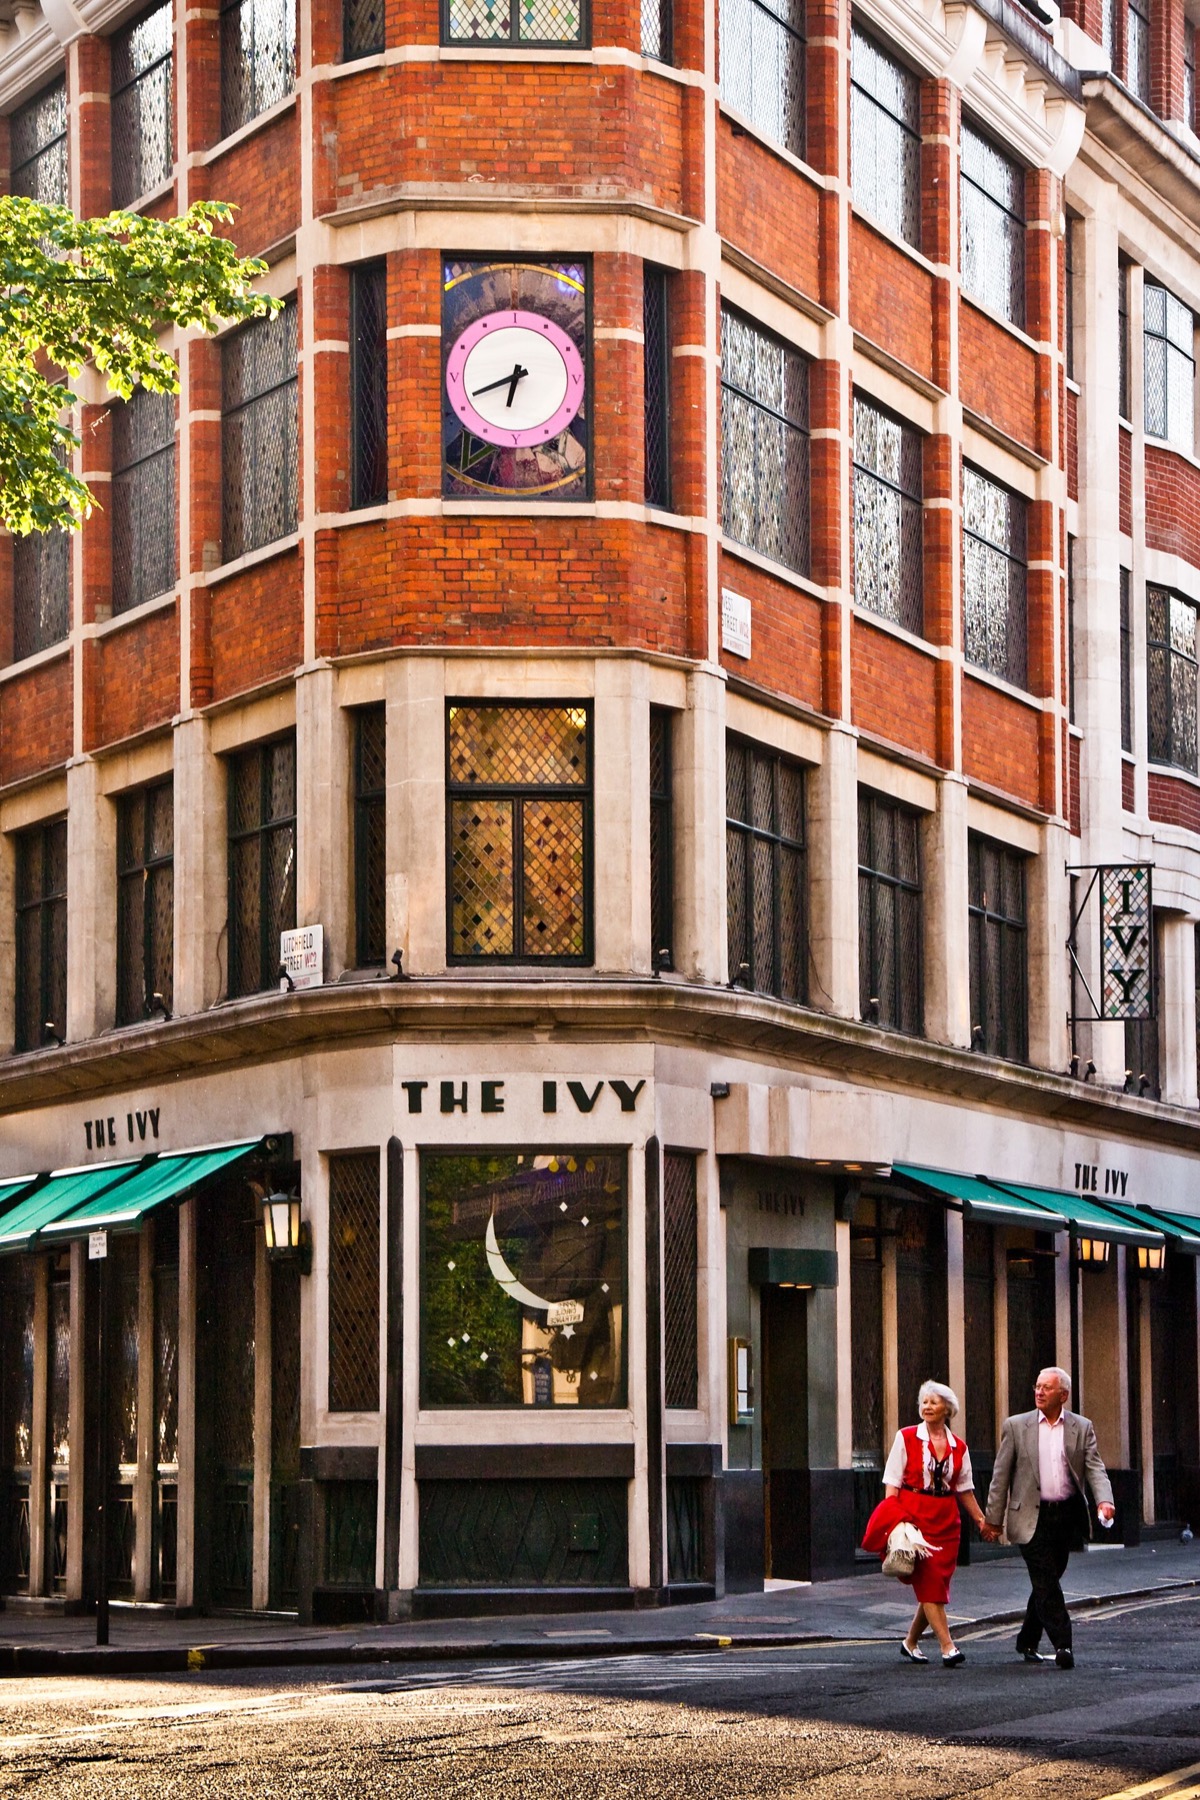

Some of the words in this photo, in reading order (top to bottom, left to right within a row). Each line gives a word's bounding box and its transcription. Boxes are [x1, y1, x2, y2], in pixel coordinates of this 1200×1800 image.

[284, 933, 314, 953] LITCHFIELD
[1108, 880, 1144, 1003] IVY
[304, 951, 317, 968] WC2
[401, 1081, 505, 1113] THE
[543, 1080, 647, 1113] IVY
[84, 1117, 116, 1150] THE
[127, 1107, 160, 1142] IVY
[1075, 1163, 1098, 1191] THE
[1105, 1169, 1129, 1197] IVY
